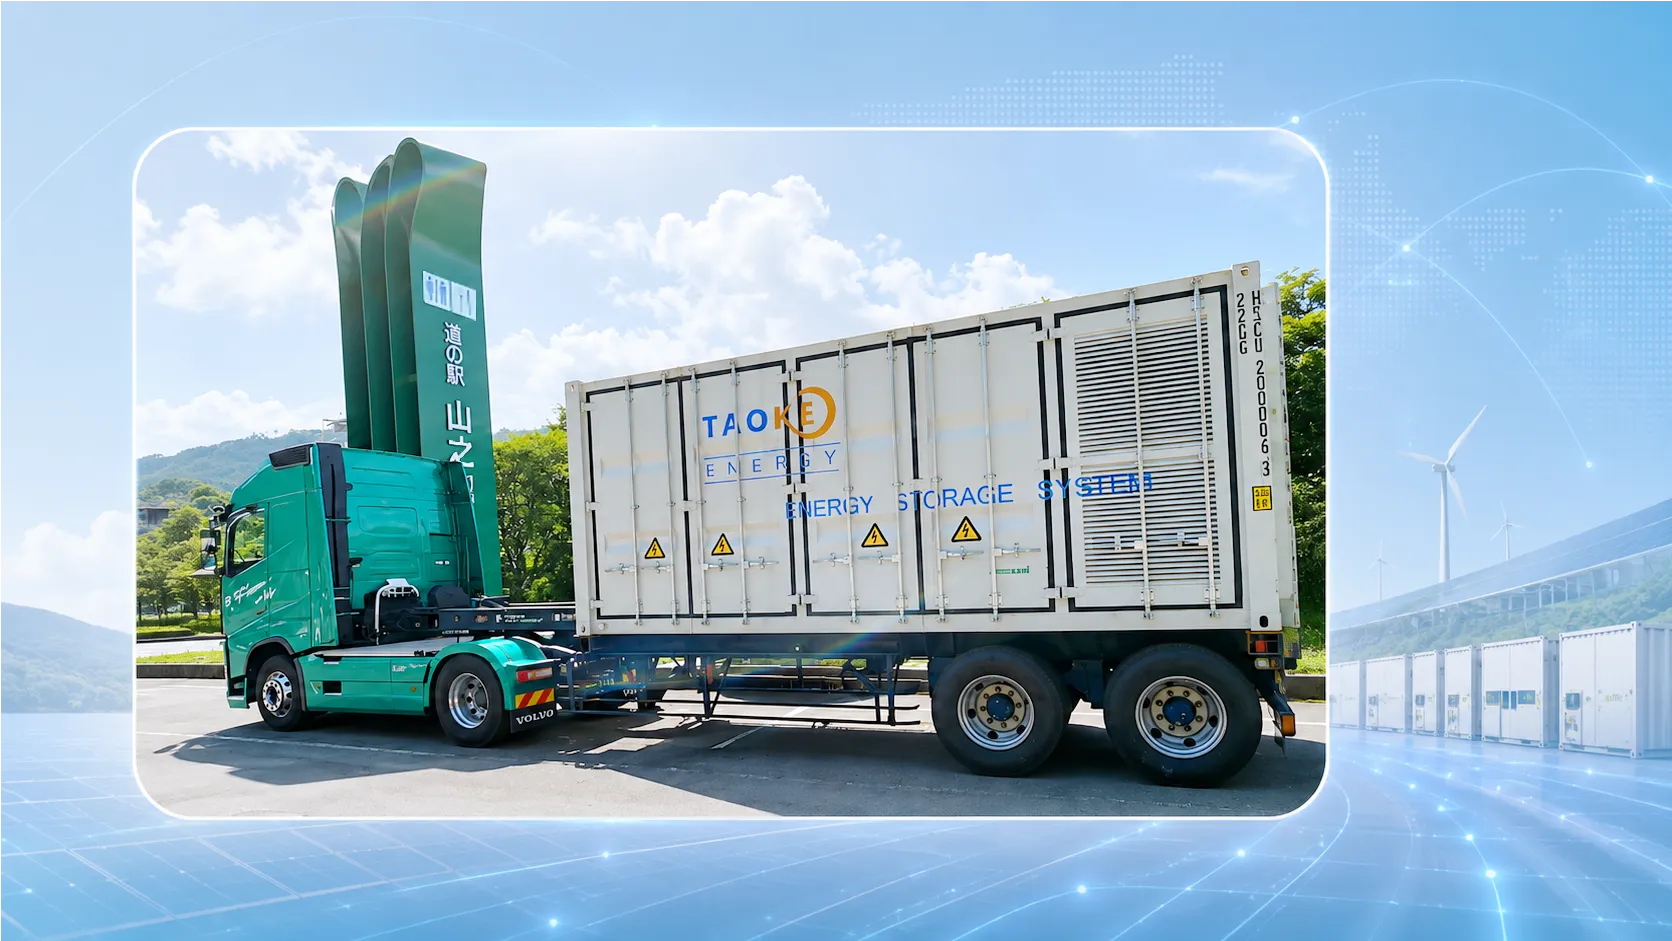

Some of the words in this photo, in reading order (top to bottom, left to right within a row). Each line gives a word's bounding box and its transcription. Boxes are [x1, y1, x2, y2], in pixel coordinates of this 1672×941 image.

[443, 321, 466, 387] 道の駅
[702, 386, 837, 440] TAOKE
[1256, 359, 1268, 454] 200006
[706, 449, 837, 477] ENERGY
[785, 496, 874, 520] ENERGY
[899, 483, 1014, 512] STORAGE
[1038, 471, 1153, 500] SYSTEM
[515, 708, 555, 726] VOLVO
